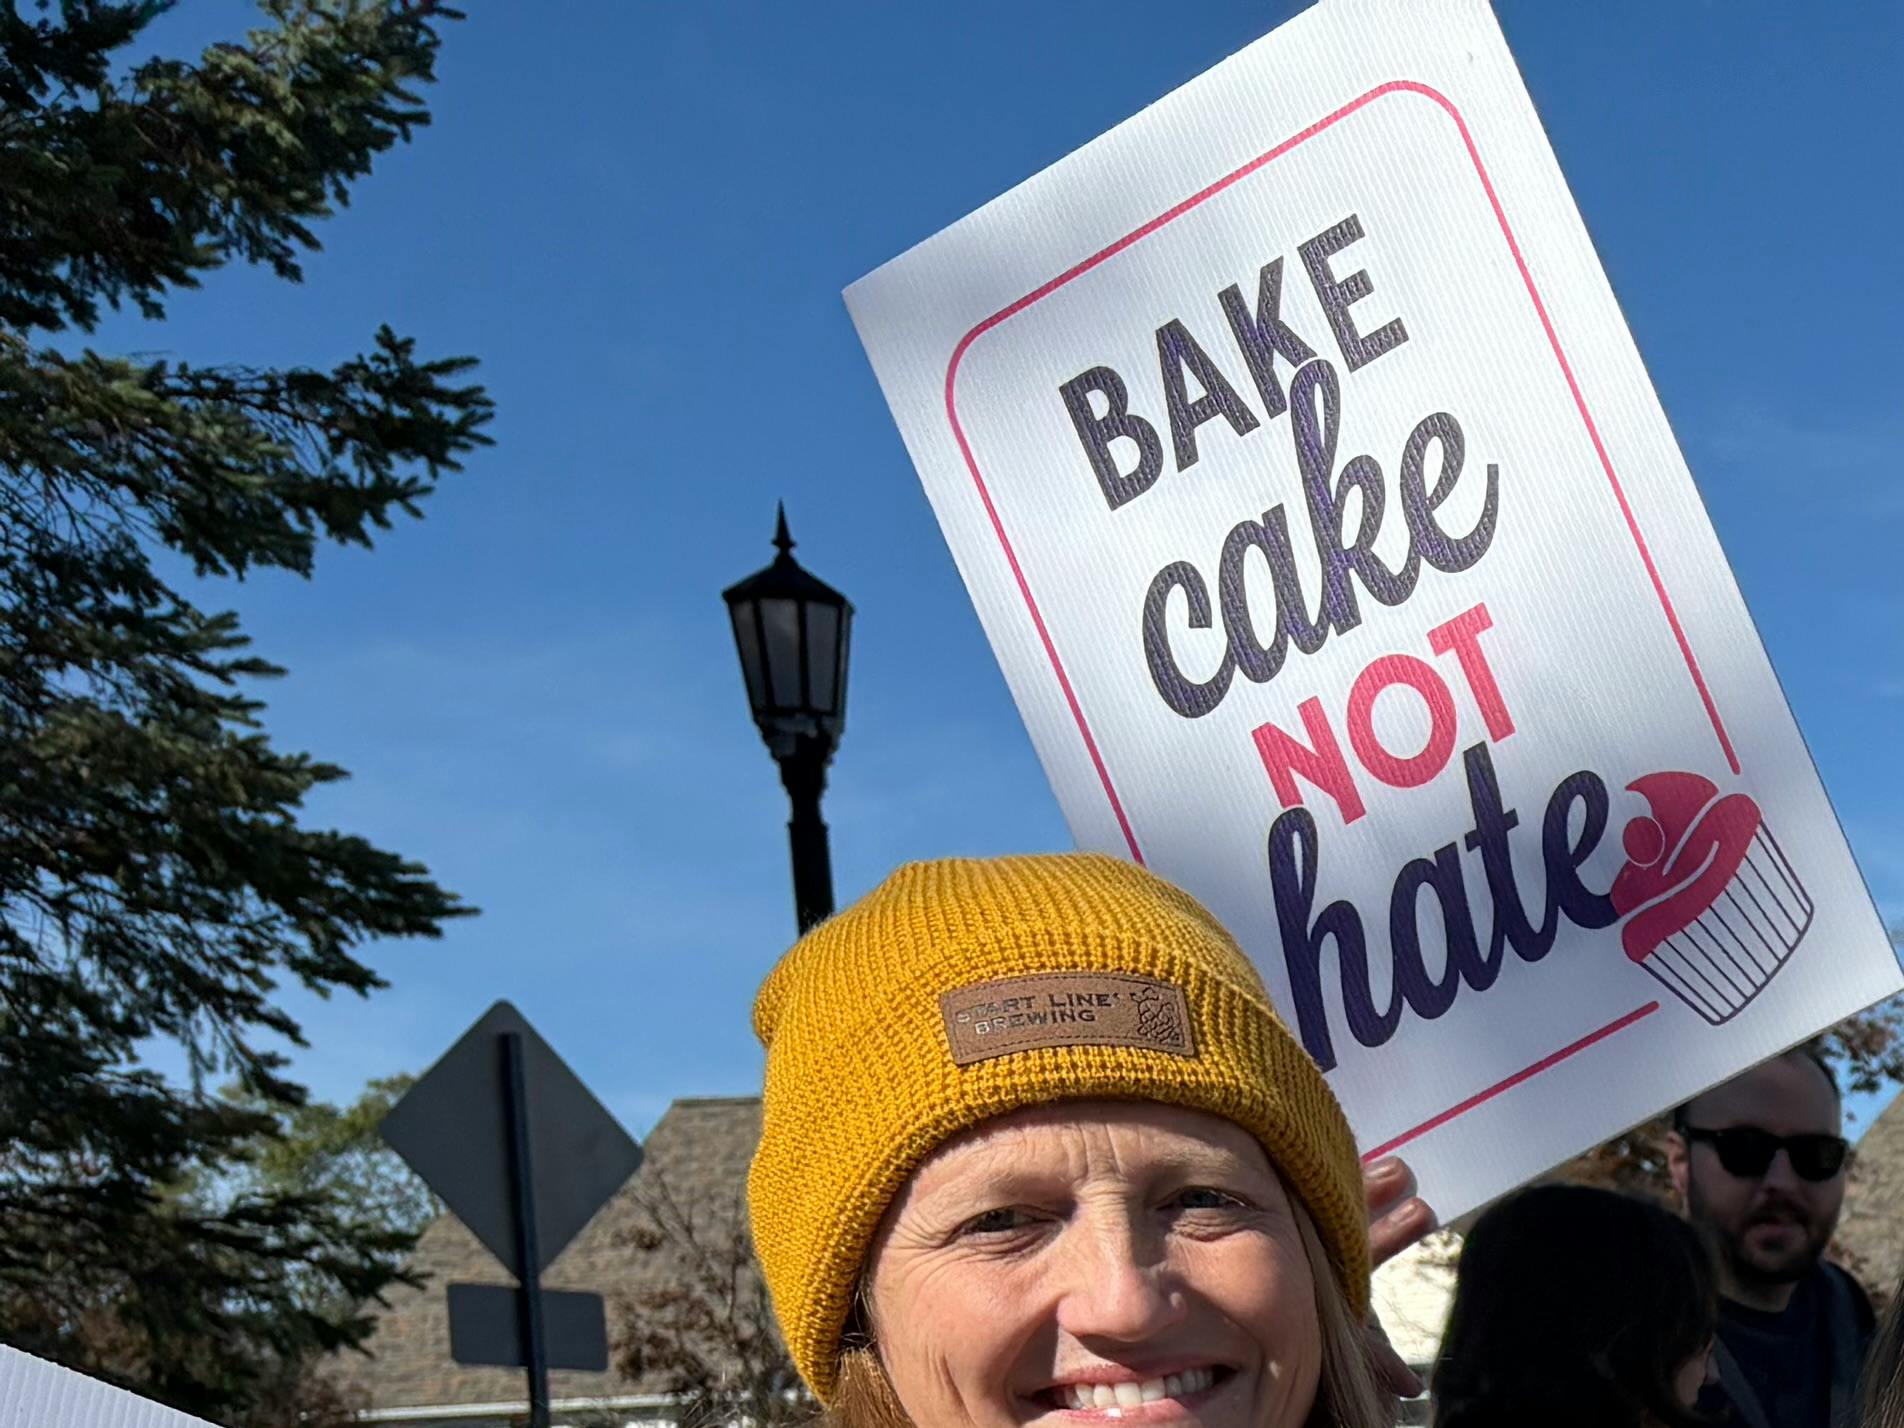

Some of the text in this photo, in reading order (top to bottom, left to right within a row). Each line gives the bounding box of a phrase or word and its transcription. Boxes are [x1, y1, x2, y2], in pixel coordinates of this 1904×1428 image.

[1059, 214, 1409, 511] BAKE
[1142, 358, 1499, 719] cake
[1252, 603, 1516, 824] NOT
[956, 995, 1035, 1023] START
[975, 1009, 1096, 1034] BREWING
[1269, 742, 1620, 1071] hate
